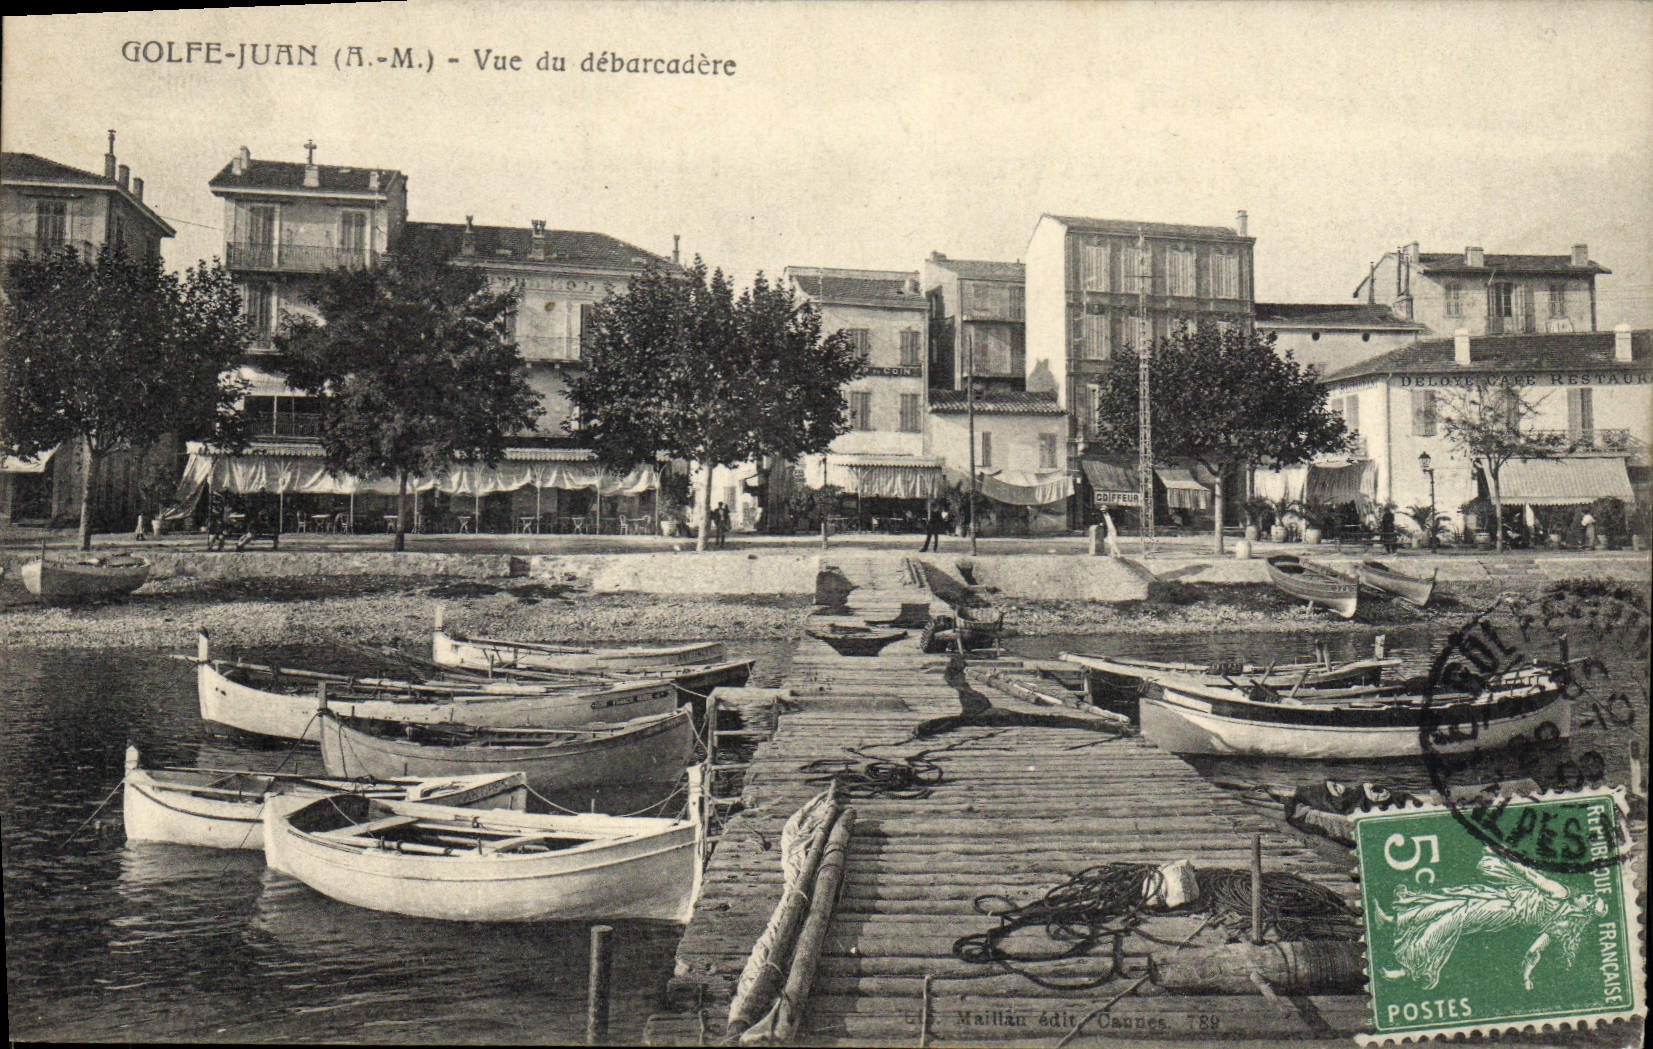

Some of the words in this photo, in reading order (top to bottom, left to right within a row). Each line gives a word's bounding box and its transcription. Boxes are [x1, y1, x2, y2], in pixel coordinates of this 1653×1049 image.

[1096, 493, 1139, 503] COIFFEUR
[1596, 921, 1624, 1005] FRANÇAISE
[1387, 998, 1473, 1024] POSTES
